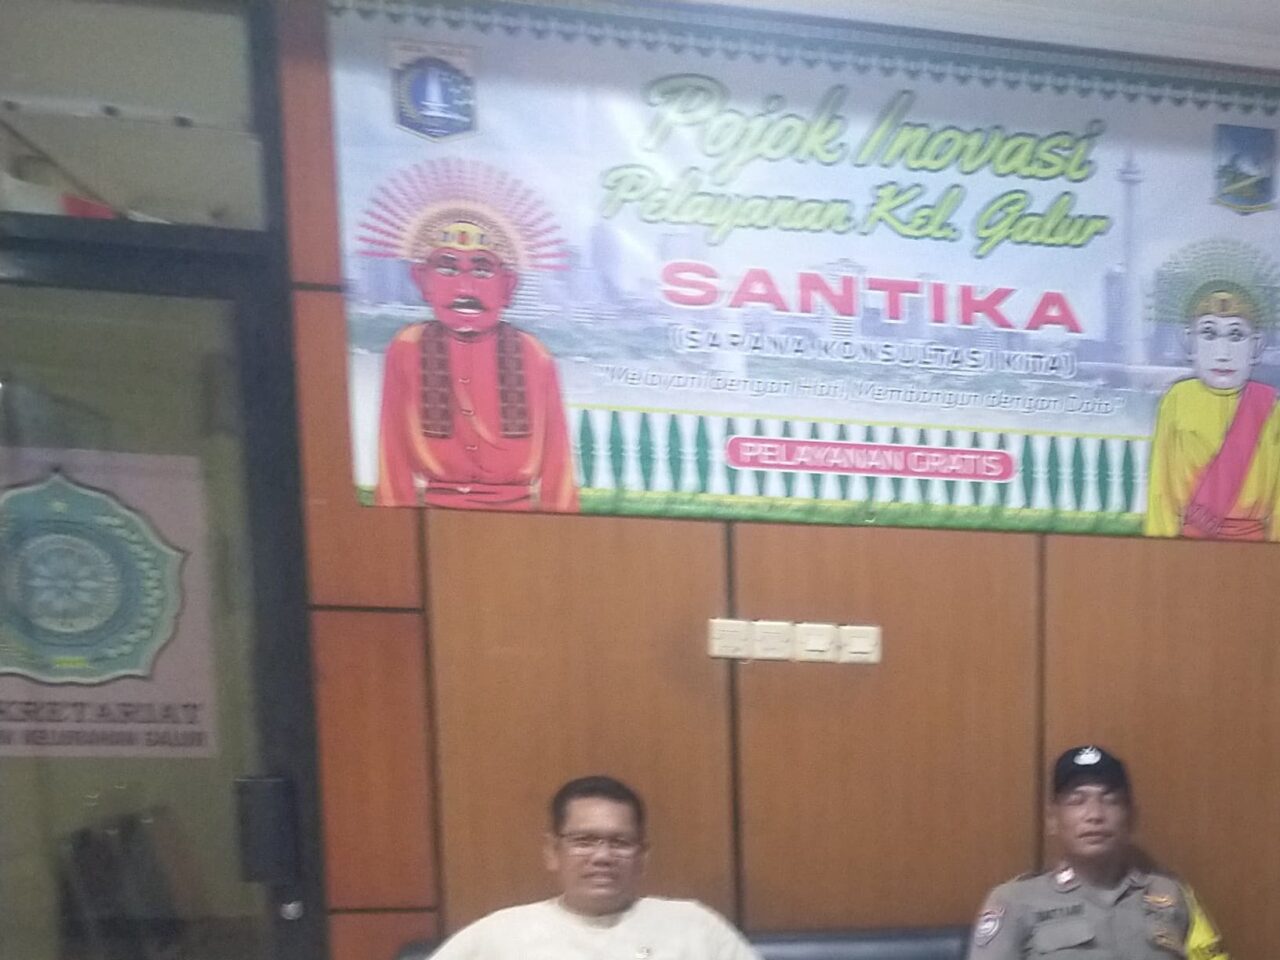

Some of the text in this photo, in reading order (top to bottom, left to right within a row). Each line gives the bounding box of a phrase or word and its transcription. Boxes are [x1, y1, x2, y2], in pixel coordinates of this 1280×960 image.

[641, 72, 1106, 185] Pojok Inovasi
[600, 163, 1112, 259] Pelayanan Kel. Galur
[660, 260, 1084, 334] SANTIKA
[816, 336, 996, 372] KONSULTASI
[1001, 351, 1078, 379] KITA)
[739, 442, 1005, 476] PELAYANAN GRATIS
